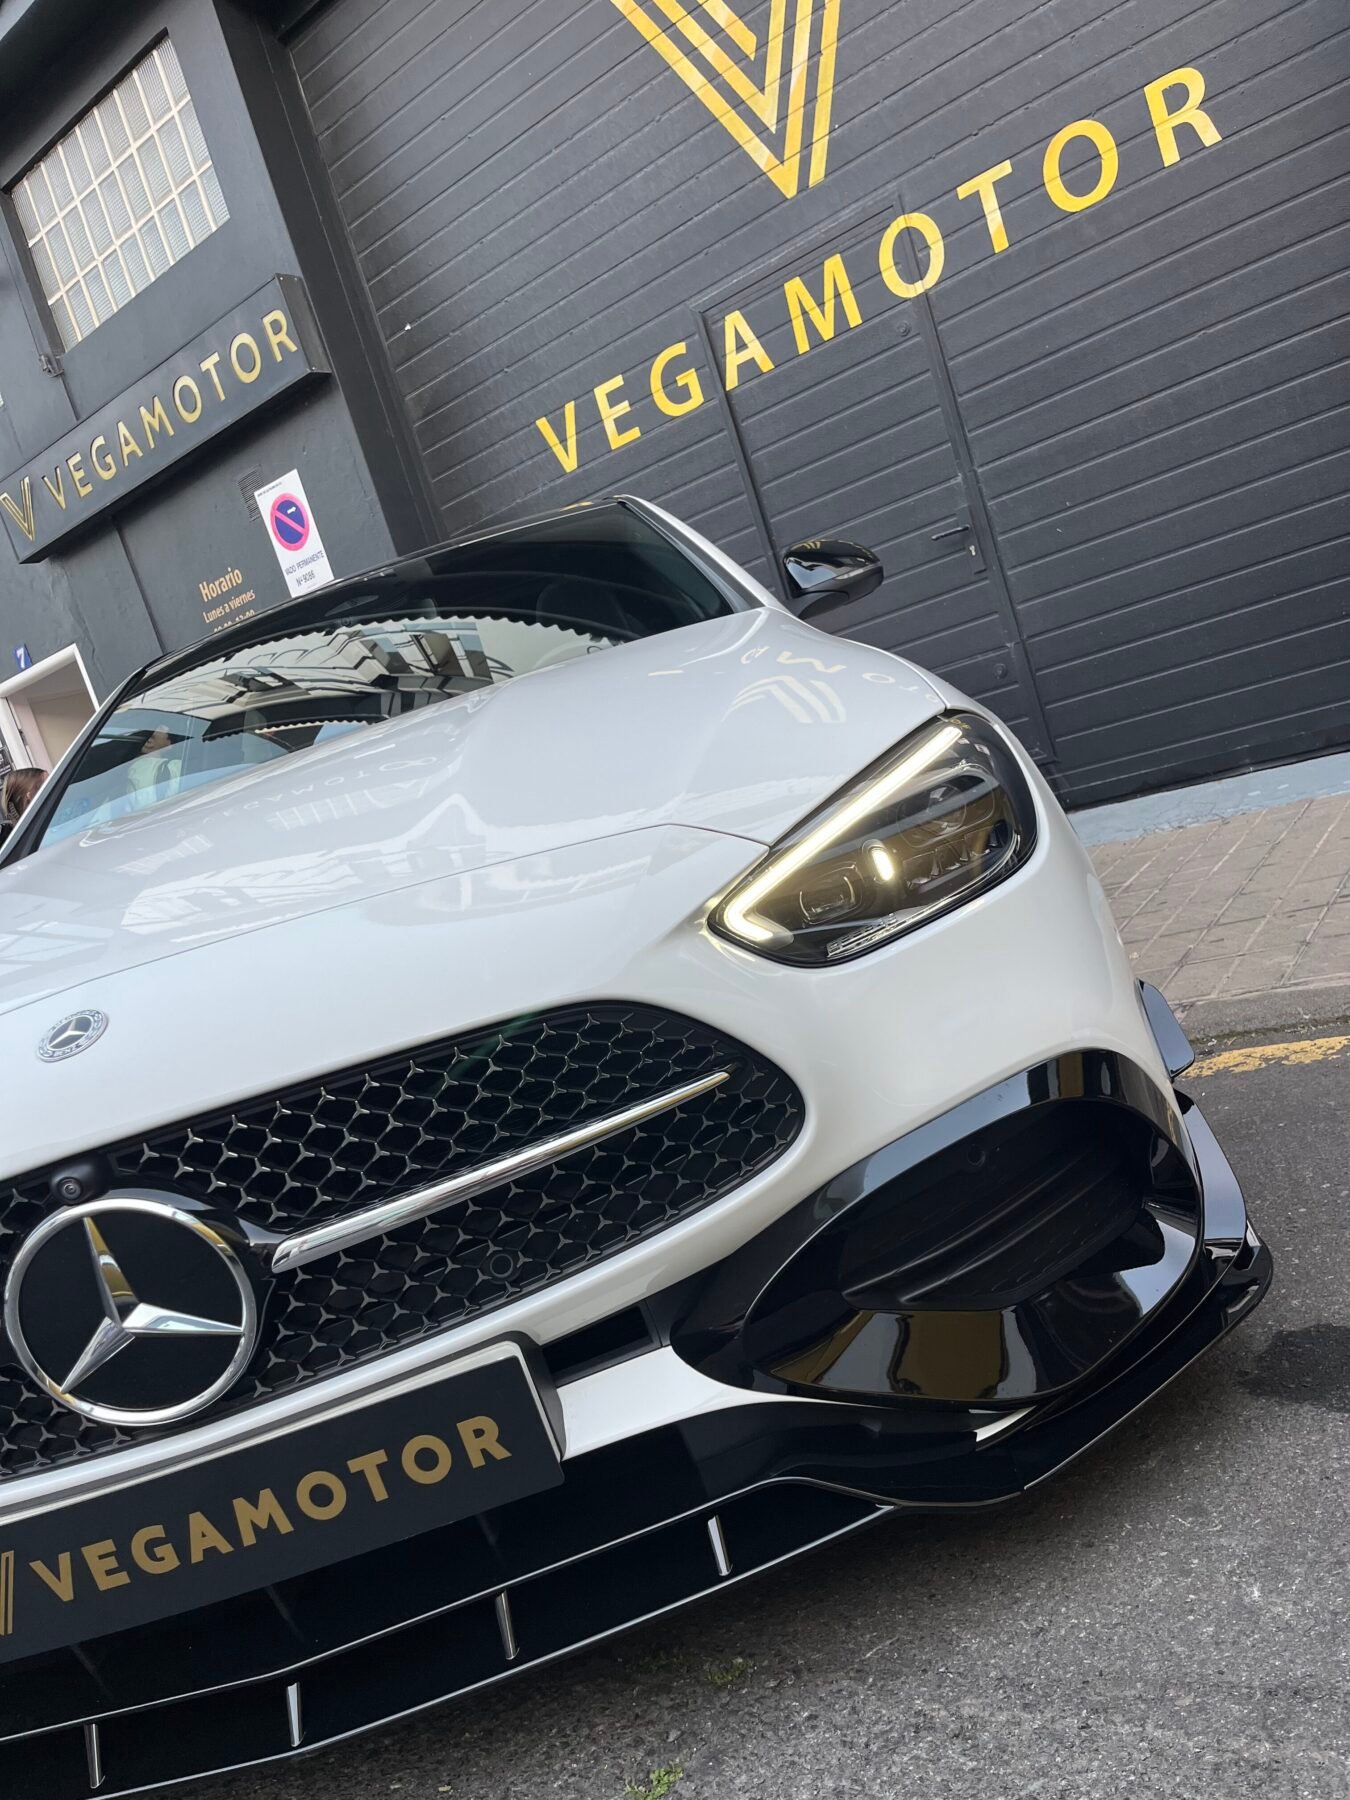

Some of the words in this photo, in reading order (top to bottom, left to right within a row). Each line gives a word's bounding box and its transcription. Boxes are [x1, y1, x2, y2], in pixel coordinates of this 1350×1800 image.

[535, 67, 1222, 473] VEGAMOTOR
[42, 309, 298, 510] VEGAMOTOR
[199, 567, 243, 602] Horario
[203, 606, 225, 624] Lunes
[229, 589, 256, 609] viernes
[296, 550, 325, 571] PERMANENTE
[29, 1415, 511, 1602] VEGAMOTOR
